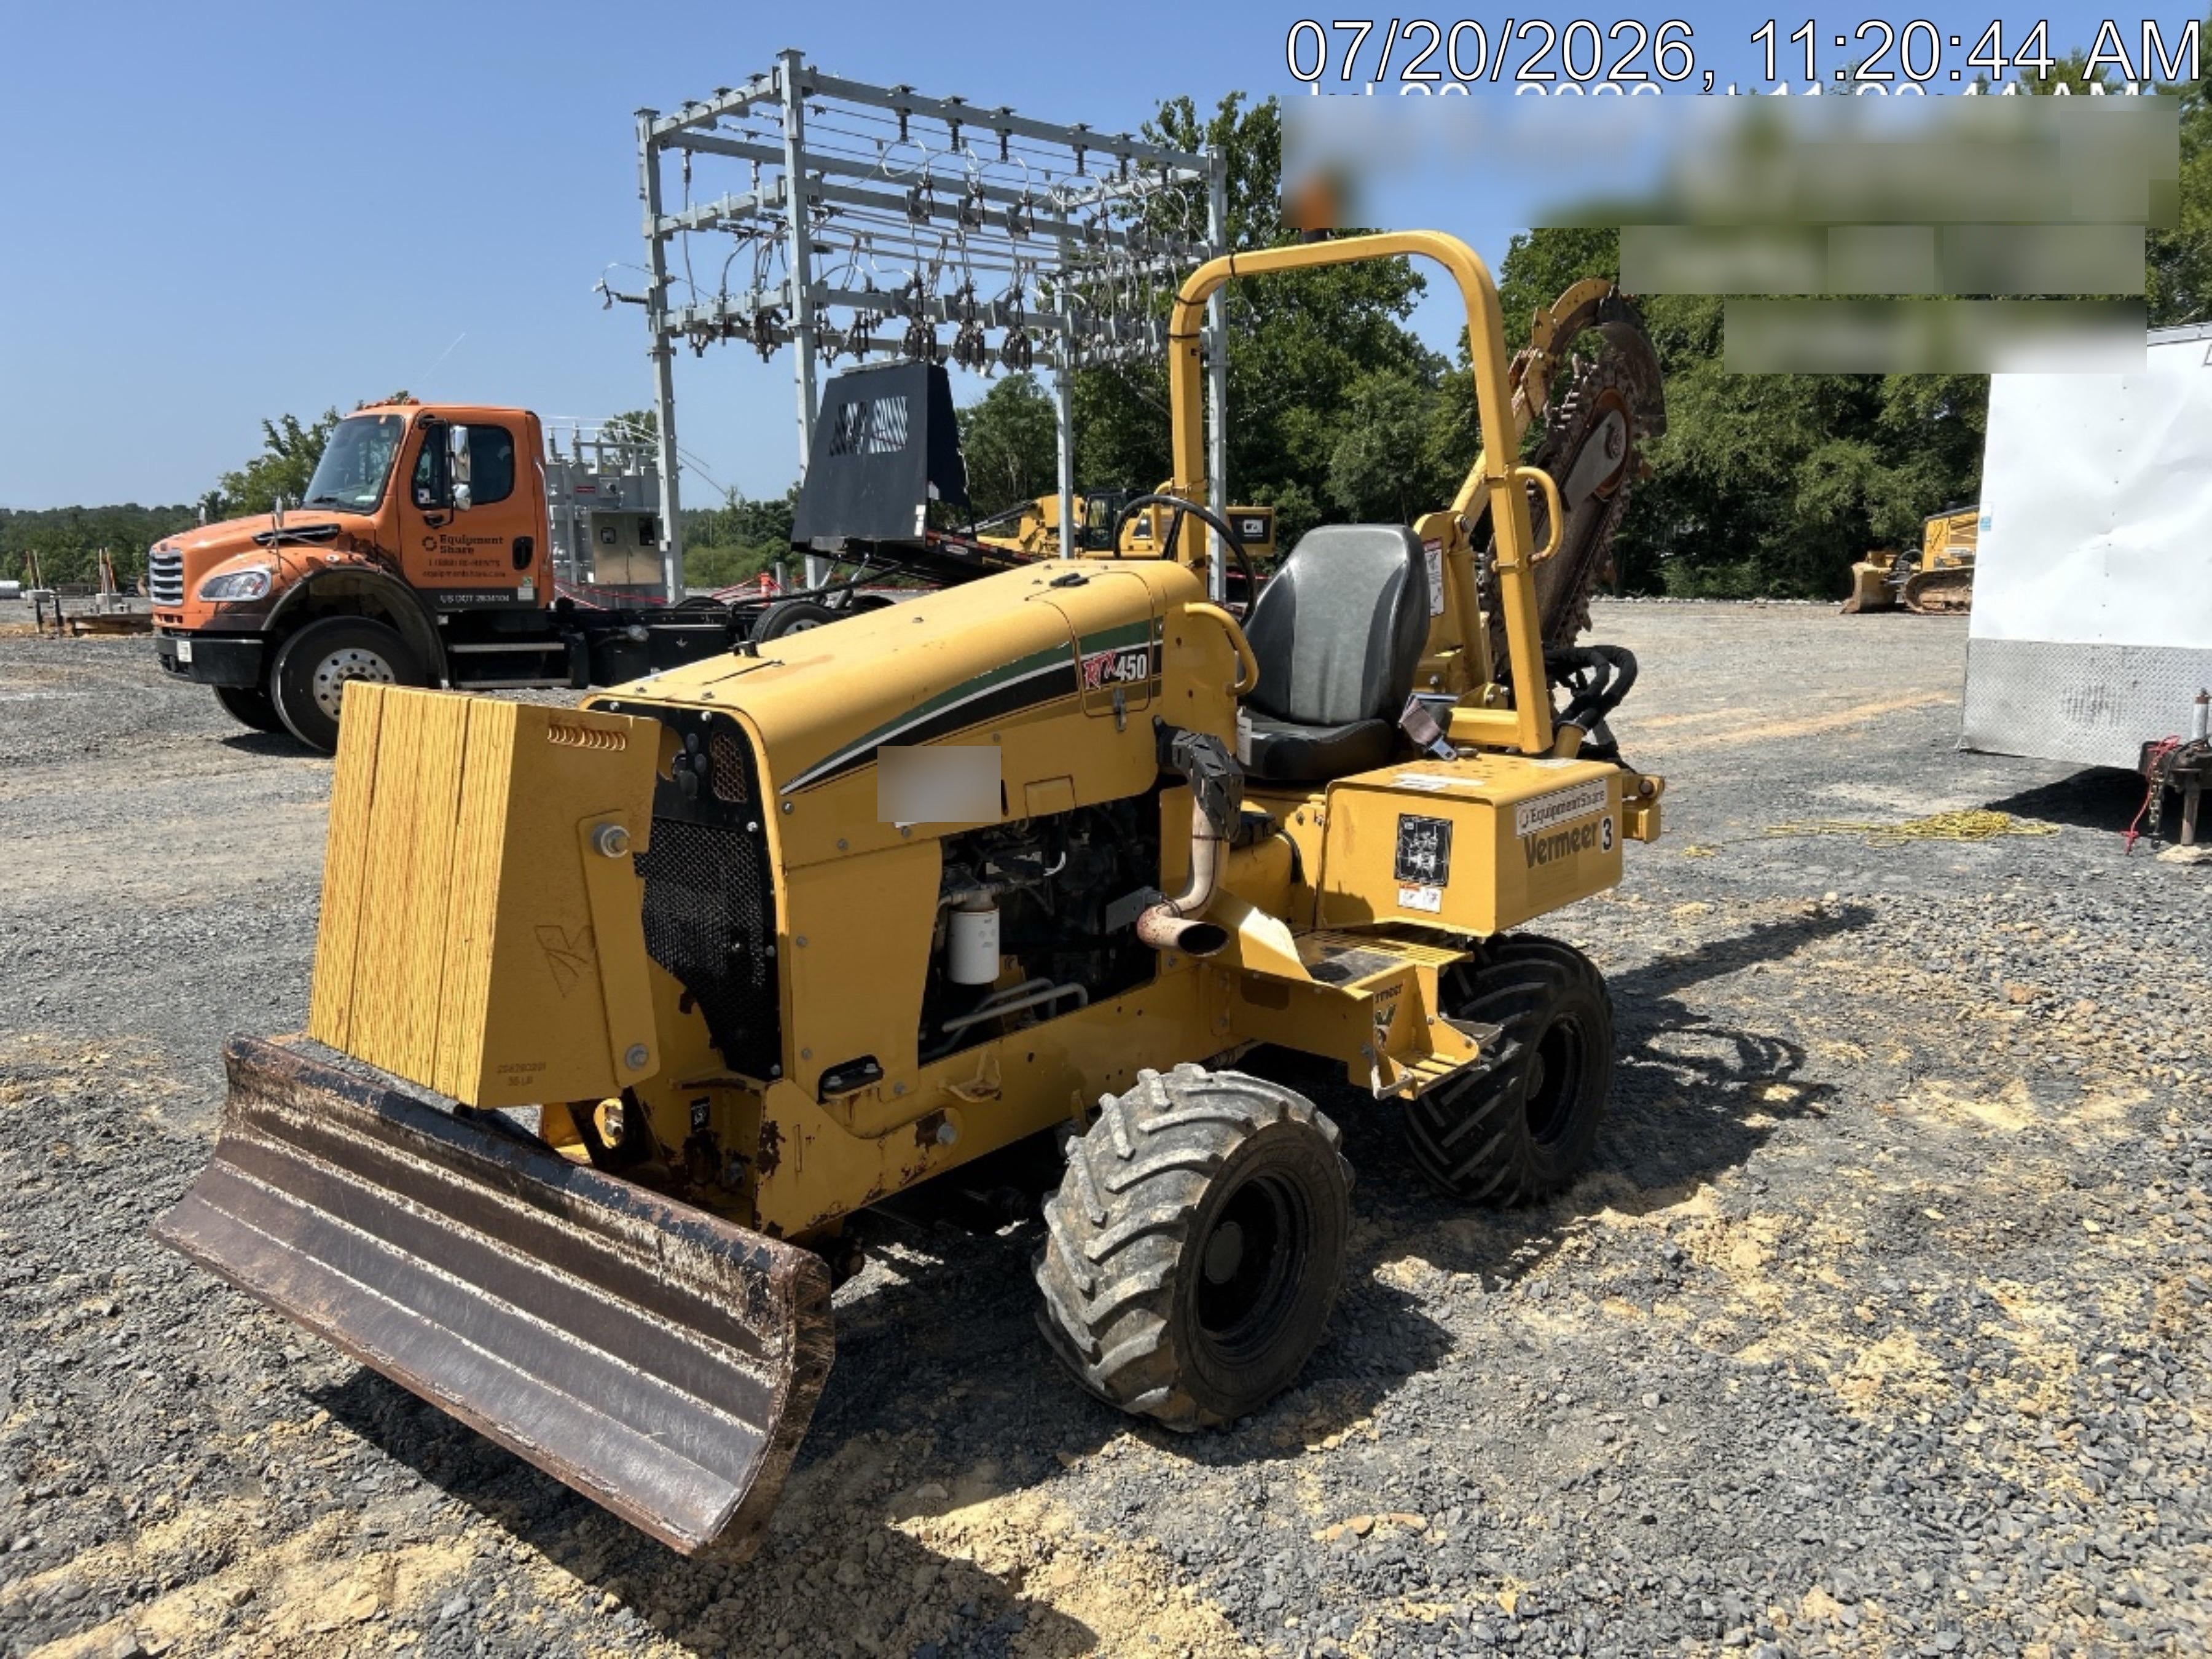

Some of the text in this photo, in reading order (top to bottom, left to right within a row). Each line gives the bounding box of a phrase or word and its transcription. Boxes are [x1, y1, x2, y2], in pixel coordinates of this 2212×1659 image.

[439, 534, 504, 546] Equipment
[440, 545, 474, 554] Share
[1530, 790, 1605, 824] EquipmentShare
[1524, 821, 1599, 869] Vermeer
[1602, 818, 1612, 851] 3
